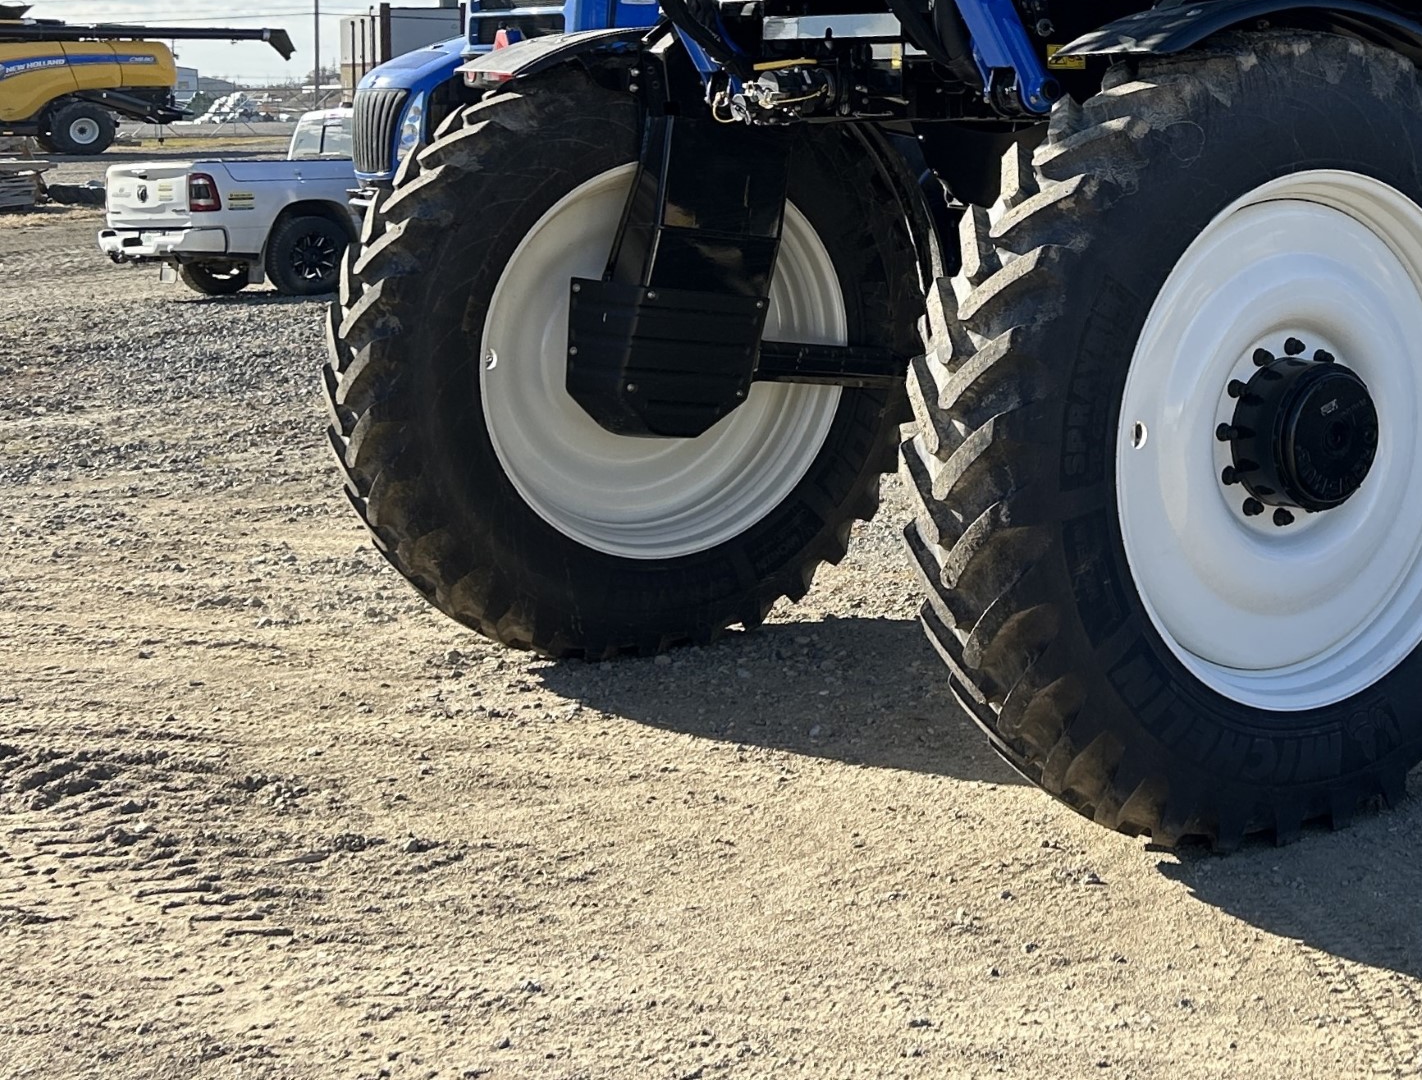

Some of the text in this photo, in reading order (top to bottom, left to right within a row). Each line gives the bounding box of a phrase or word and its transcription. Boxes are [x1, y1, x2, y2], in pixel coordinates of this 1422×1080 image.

[5, 59, 65, 74] NEW HOLLAND
[1110, 652, 1342, 782] MICHELIN
